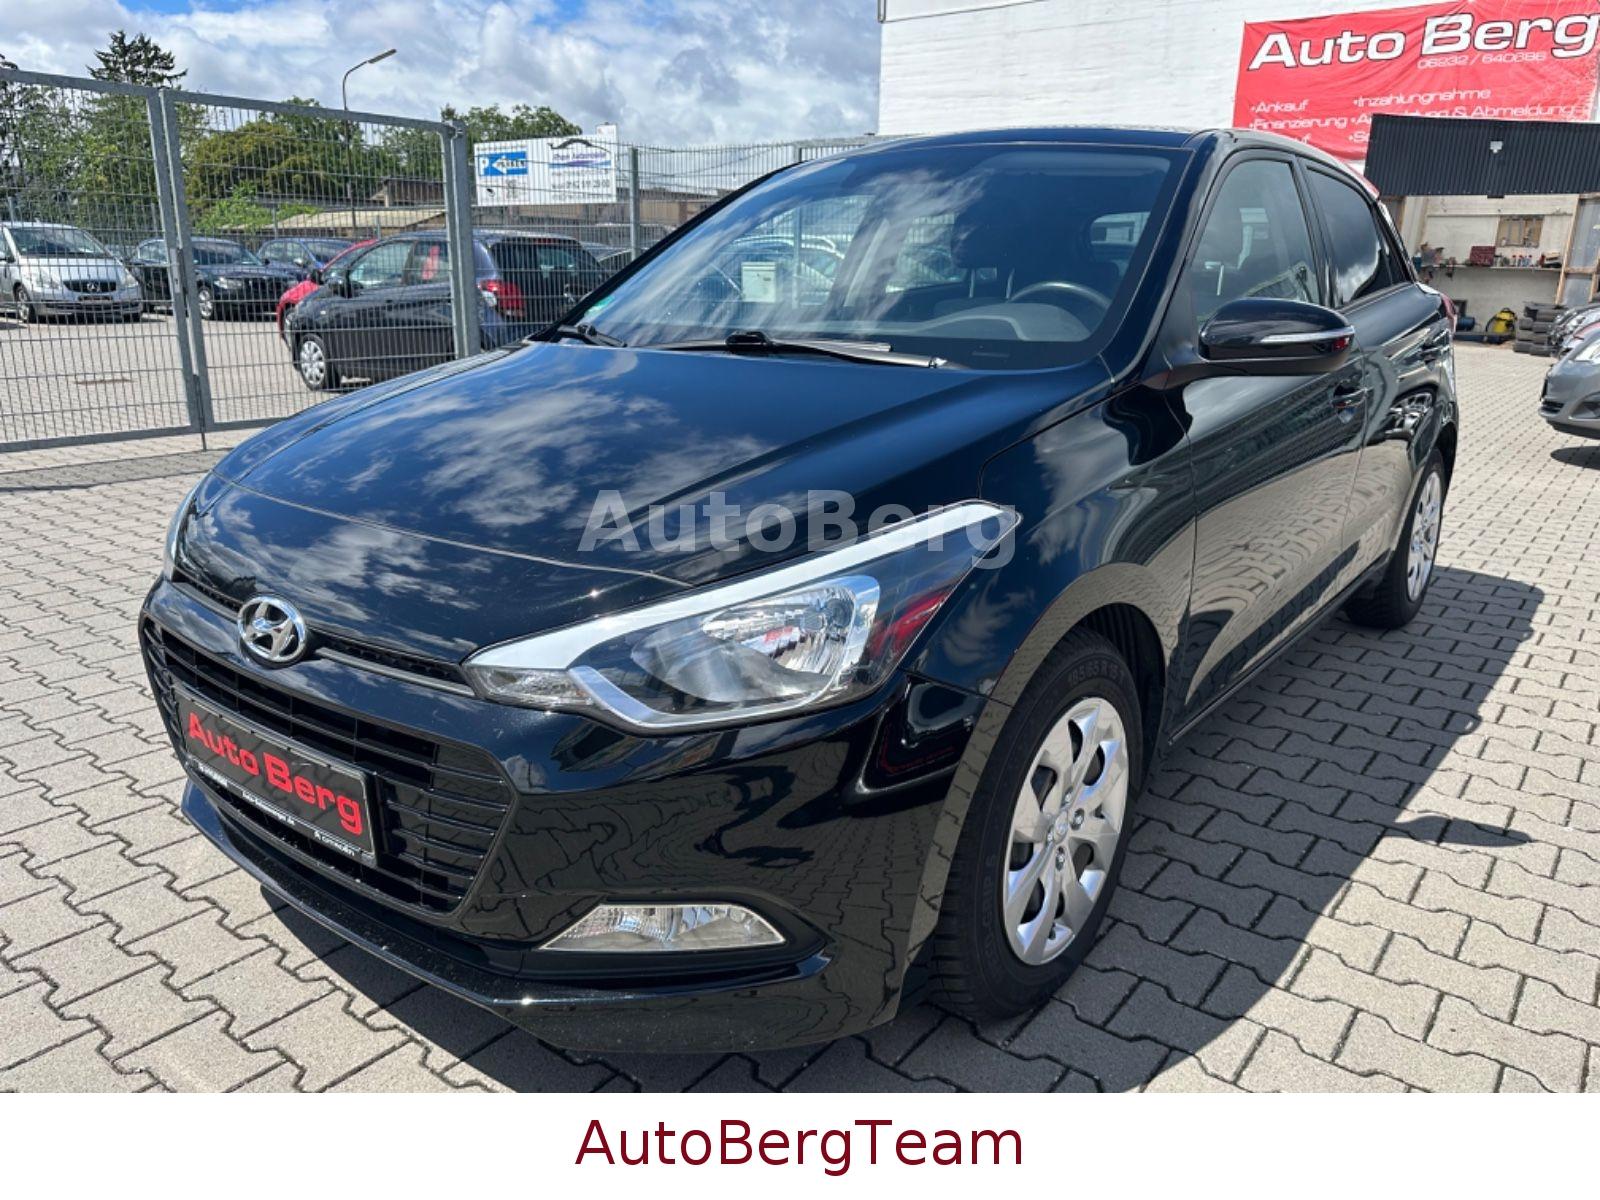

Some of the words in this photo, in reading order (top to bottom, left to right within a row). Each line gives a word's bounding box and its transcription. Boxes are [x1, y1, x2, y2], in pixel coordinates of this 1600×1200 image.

[1247, 30, 1406, 71] Auto
[1421, 12, 1600, 58] Berg
[188, 712, 259, 776] Auto
[263, 752, 363, 836] Berg
